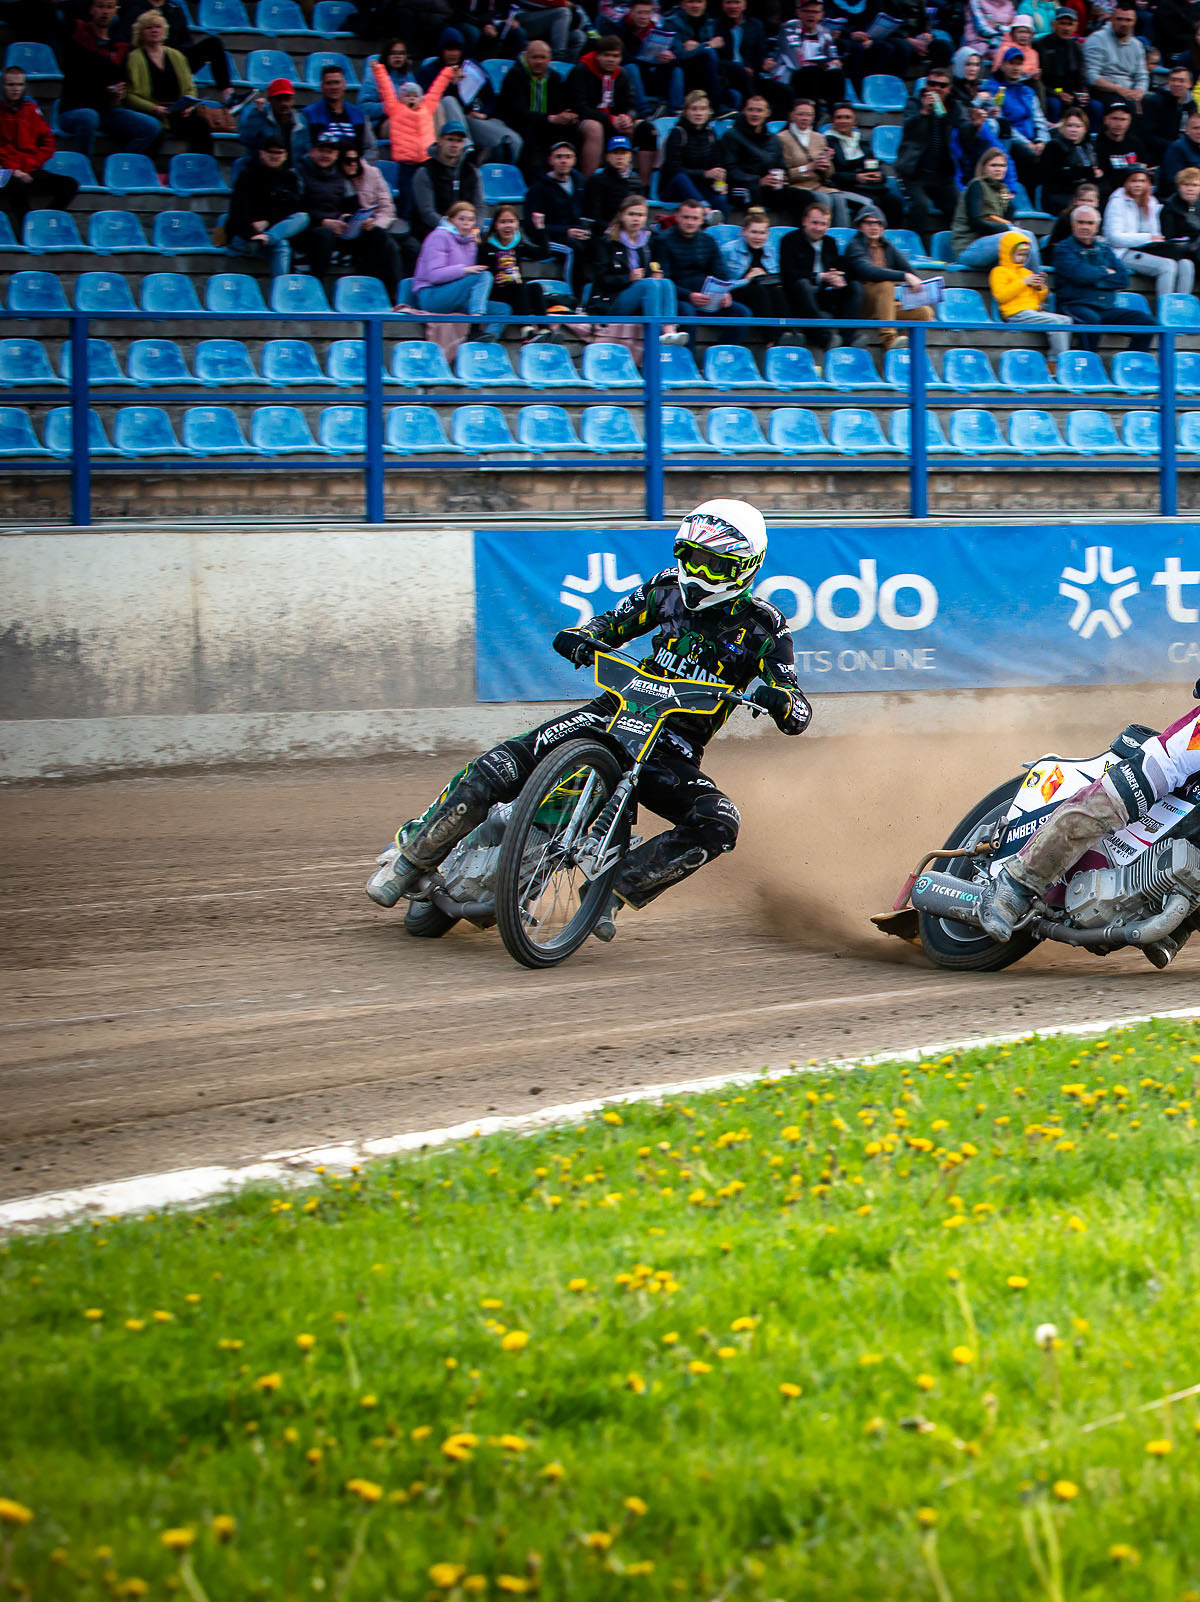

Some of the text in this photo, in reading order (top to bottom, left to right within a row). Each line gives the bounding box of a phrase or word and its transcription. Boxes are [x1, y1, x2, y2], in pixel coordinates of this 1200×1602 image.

[750, 558, 939, 632] odo
[837, 648, 937, 672] ONLINE
[1120, 763, 1140, 791] AMBER
[1006, 820, 1037, 844] AMBER
